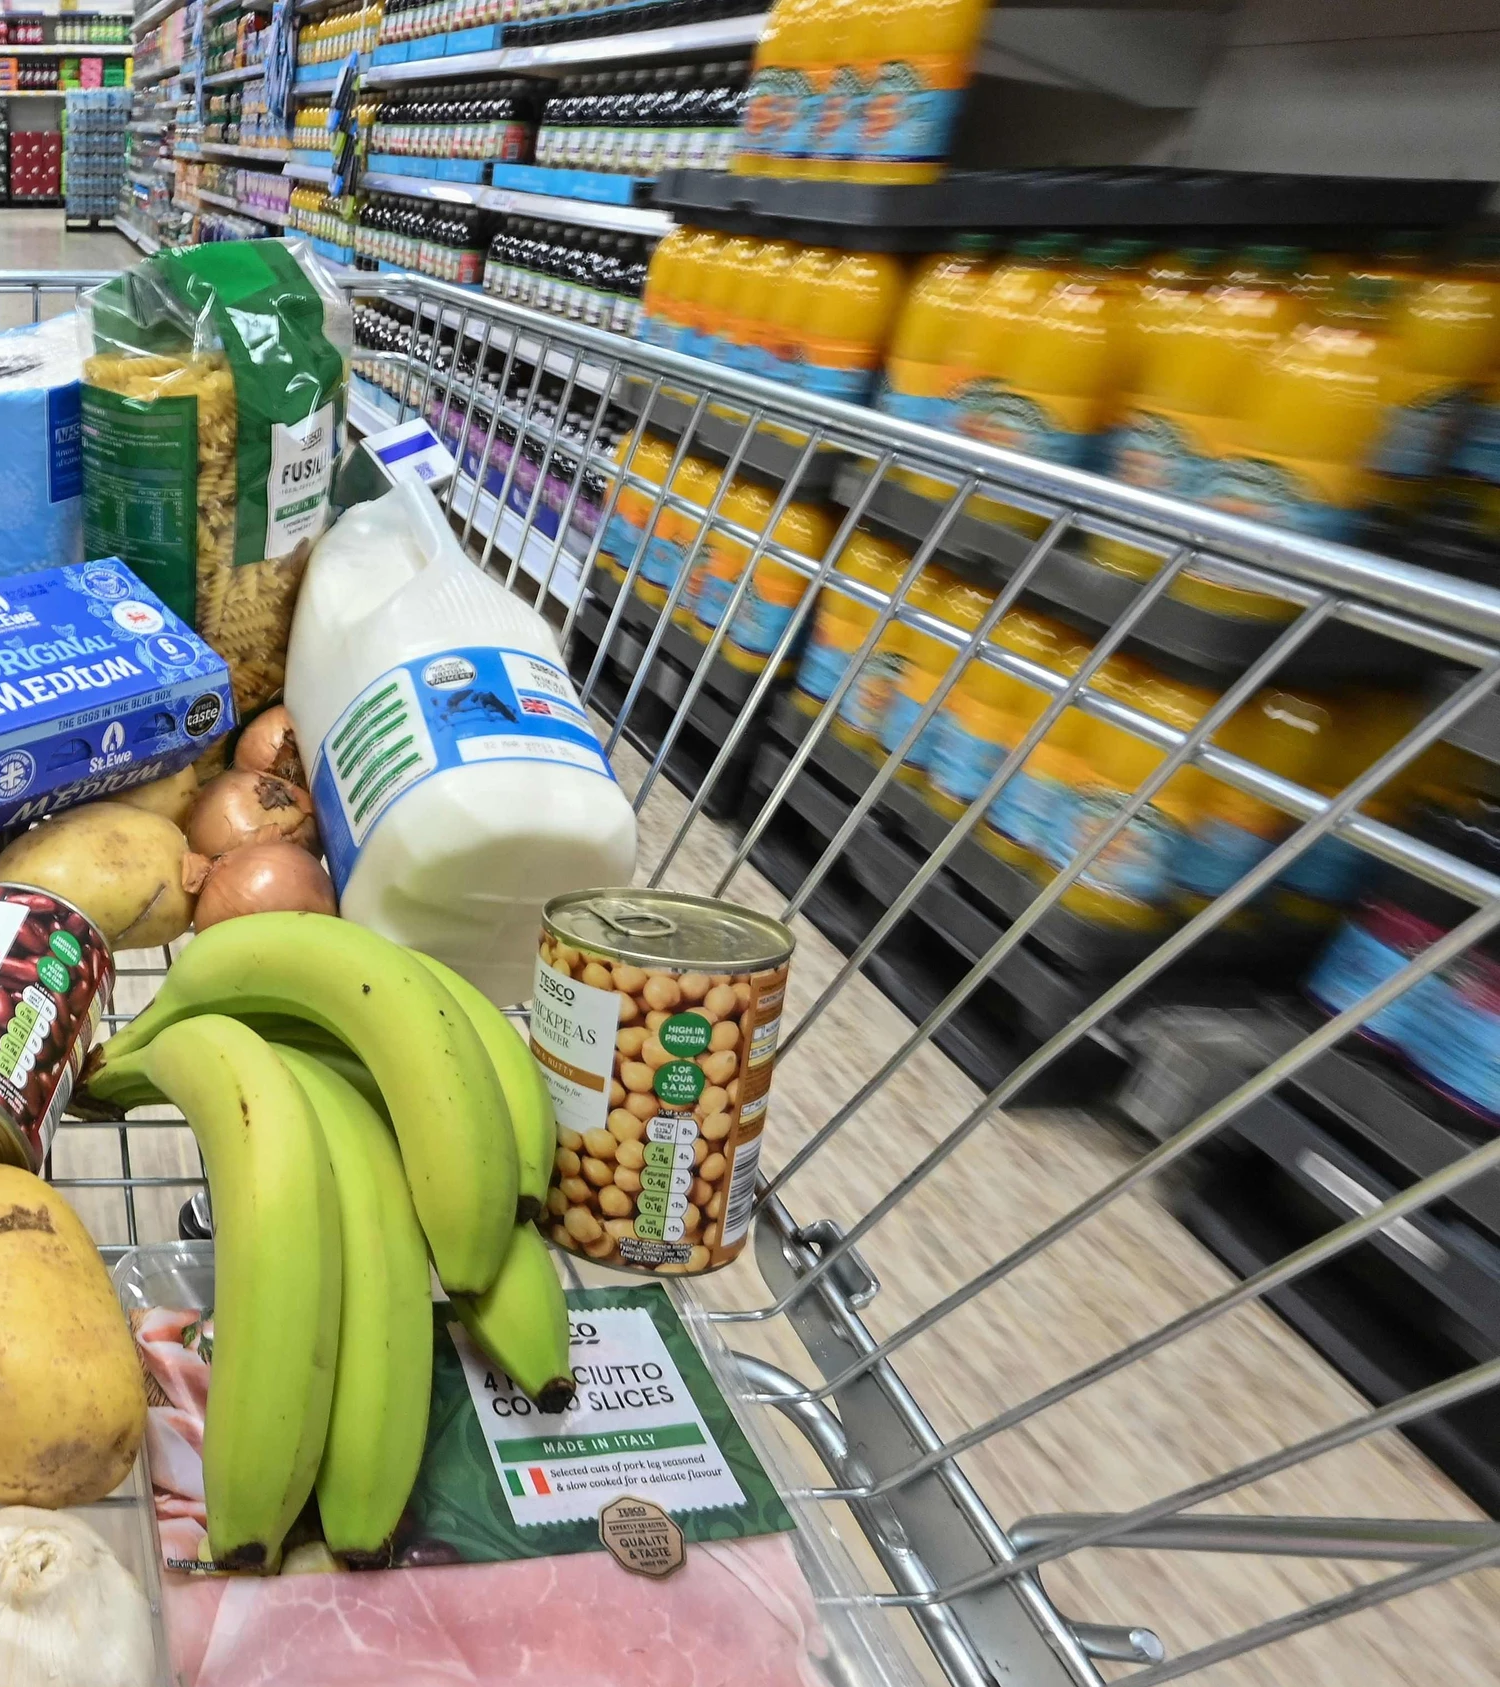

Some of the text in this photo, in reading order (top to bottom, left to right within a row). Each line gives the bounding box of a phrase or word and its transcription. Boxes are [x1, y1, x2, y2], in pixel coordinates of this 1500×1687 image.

[157, 638, 178, 655] 6
[58, 689, 172, 732] THE EGGS IN THE BLUE BOX
[187, 706, 220, 726] taste
[89, 750, 132, 773] St.Ewe
[3, 762, 165, 827] MEDIUM
[52, 939, 77, 962] PROTEIN
[47, 964, 64, 980] YOUR
[540, 969, 575, 1001] TESCO
[542, 1024, 569, 1048] WATER
[668, 1025, 705, 1035] HIGH IN
[665, 1033, 705, 1044] PROTEIN
[547, 1057, 574, 1077] NUTTY
[678, 1066, 692, 1074] OF
[667, 1074, 693, 1083] YOUR
[570, 1088, 582, 1098] for
[661, 1082, 696, 1092] 5 A DAY
[647, 1177, 686, 1189] 0.4g 2%
[644, 1194, 664, 1202] Sugars
[645, 1201, 662, 1213] 0.1g
[639, 1225, 662, 1237] 0.01g
[484, 1371, 498, 1392] 4
[588, 1385, 675, 1412] SLICES
[542, 1433, 656, 1454] MADE IN ITALY
[550, 1454, 706, 1478] Selected cuts of pork leg seasoned
[556, 1468, 723, 1492] & slow cooked for a delicate flavour
[616, 1506, 647, 1517] TESCO
[608, 1521, 667, 1531] EXPERTLY SELECTED
[620, 1535, 669, 1548] QUALITY
[629, 1547, 671, 1560] & TASTE
[168, 1558, 197, 1569] Serving
